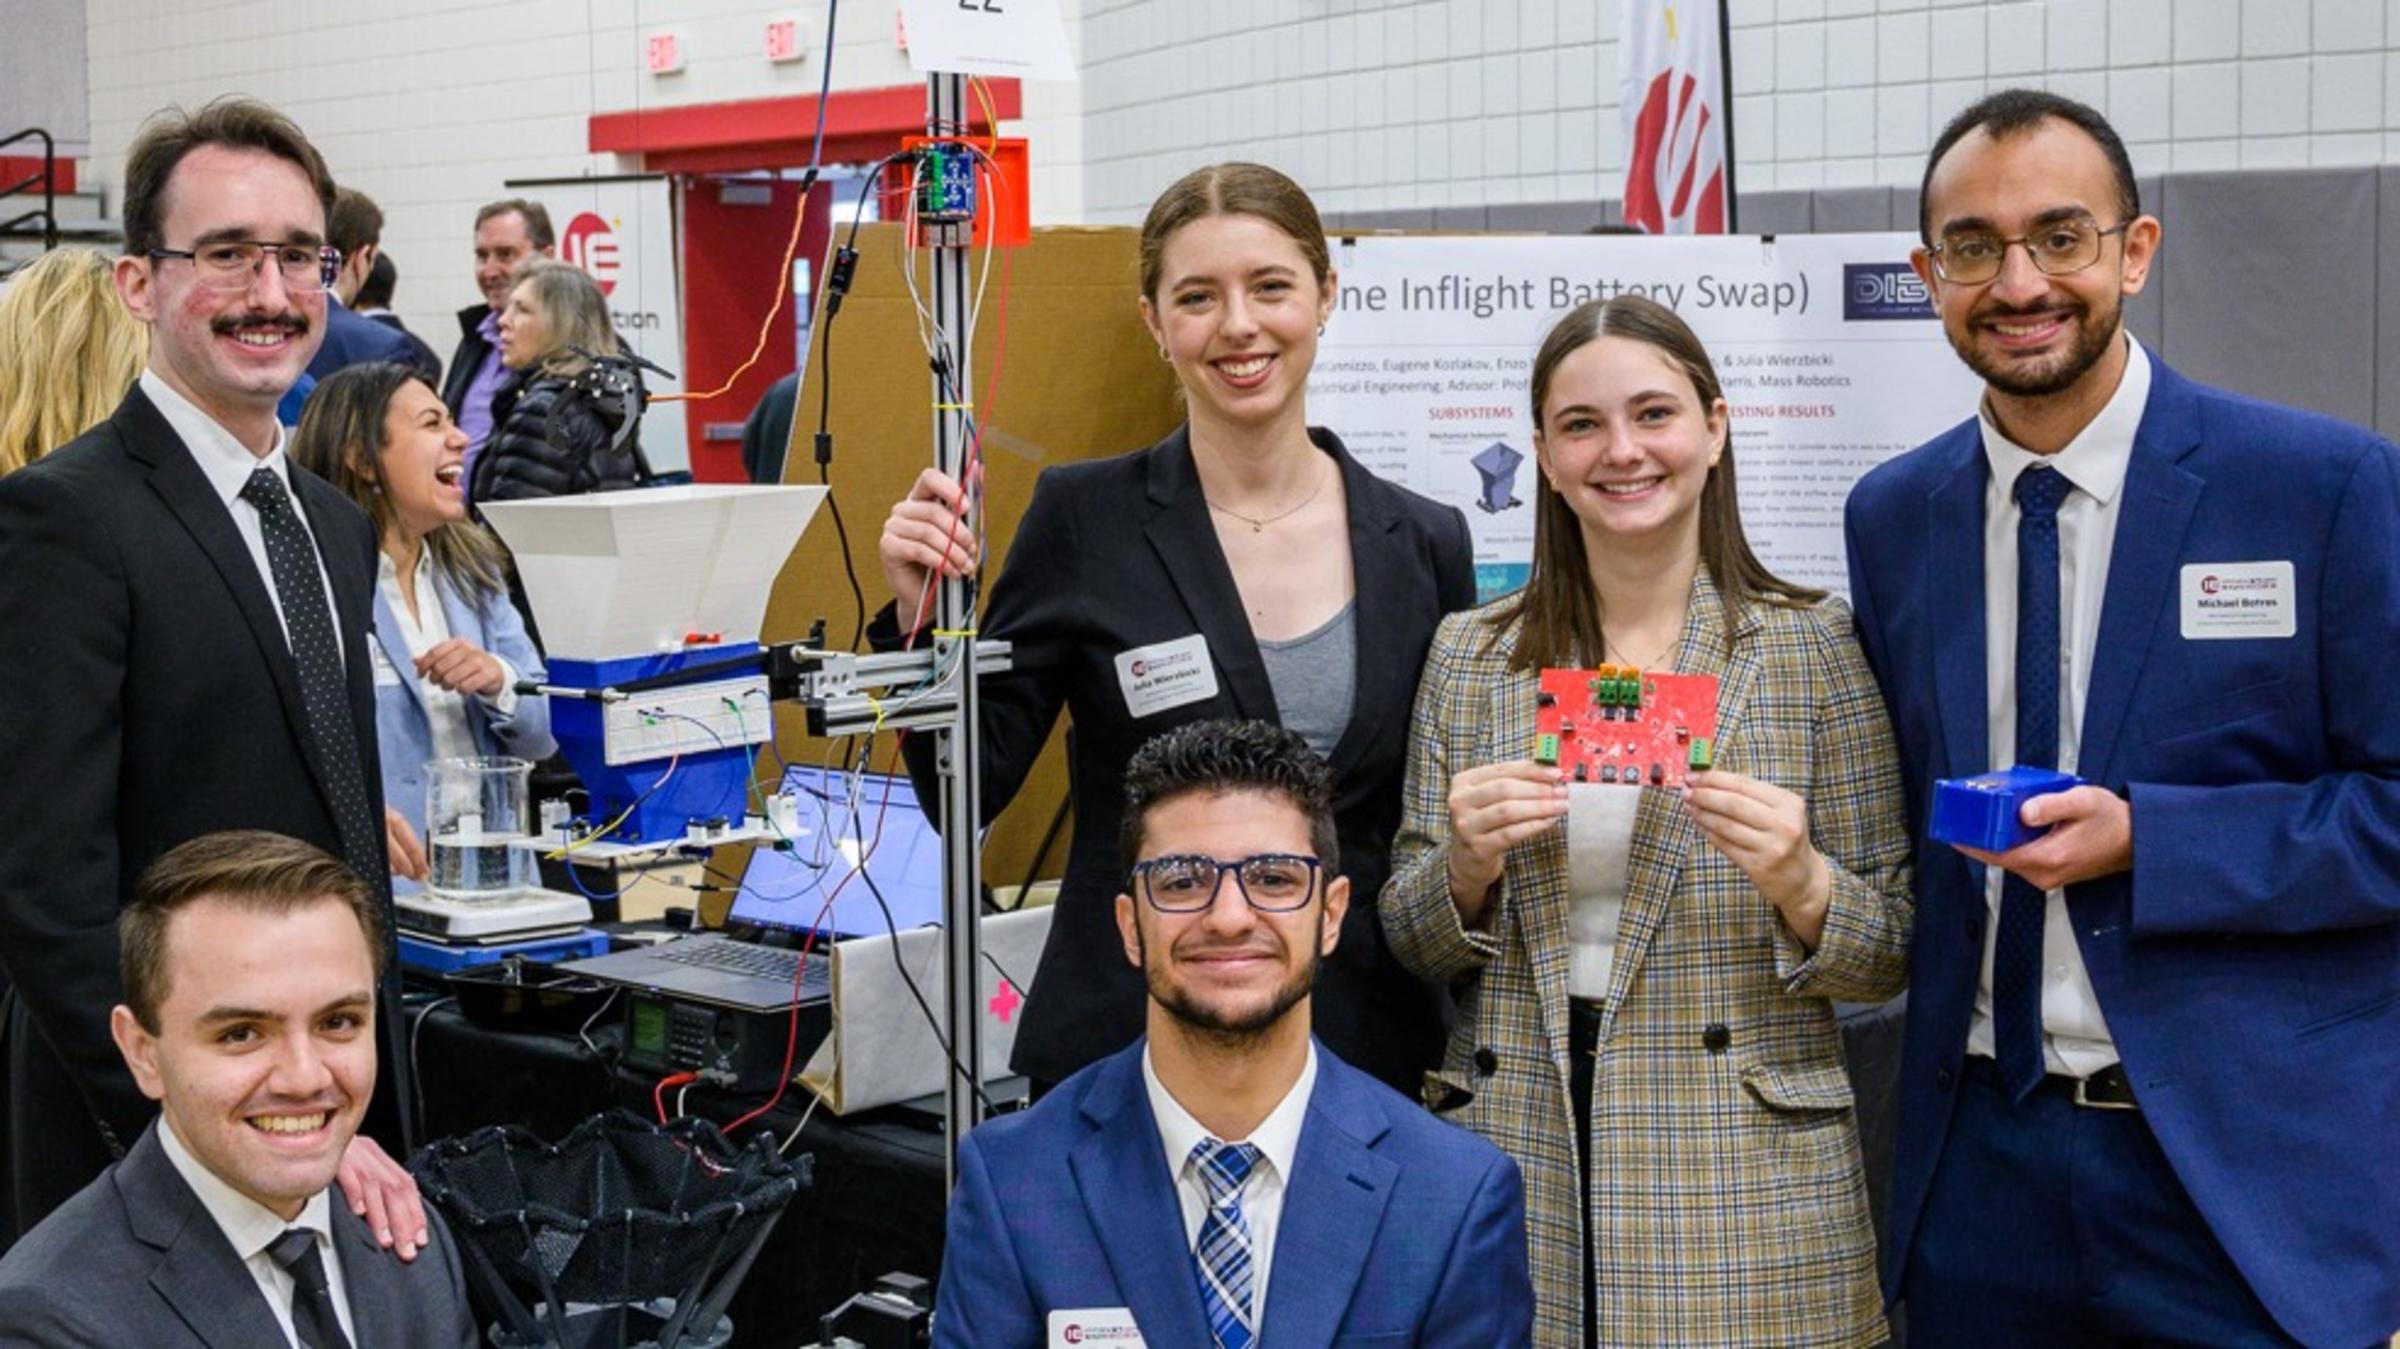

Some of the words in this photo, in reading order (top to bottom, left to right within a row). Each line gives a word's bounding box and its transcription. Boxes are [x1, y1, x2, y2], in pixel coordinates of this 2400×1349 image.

[1341, 285, 1387, 311] ne
[1402, 275, 1535, 318] Inflight
[1697, 272, 1809, 315] Swap)
[612, 310, 659, 329] tion
[1383, 359, 1430, 373] Eugene
[1433, 357, 1494, 371] Kozlakov,
[1497, 357, 1528, 370] Enzo
[1736, 354, 1763, 366] Julia
[1766, 353, 1833, 367] Wierzbicki
[1447, 379, 1499, 391] Advisor:
[1759, 374, 1793, 387] Mass
[1796, 374, 1851, 387] Robotics
[1428, 406, 1515, 420] SUBSYSTEMS
[1729, 404, 1775, 418] ESTING
[1777, 403, 1836, 418] RESULTS
[2197, 598, 2240, 608] Michael
